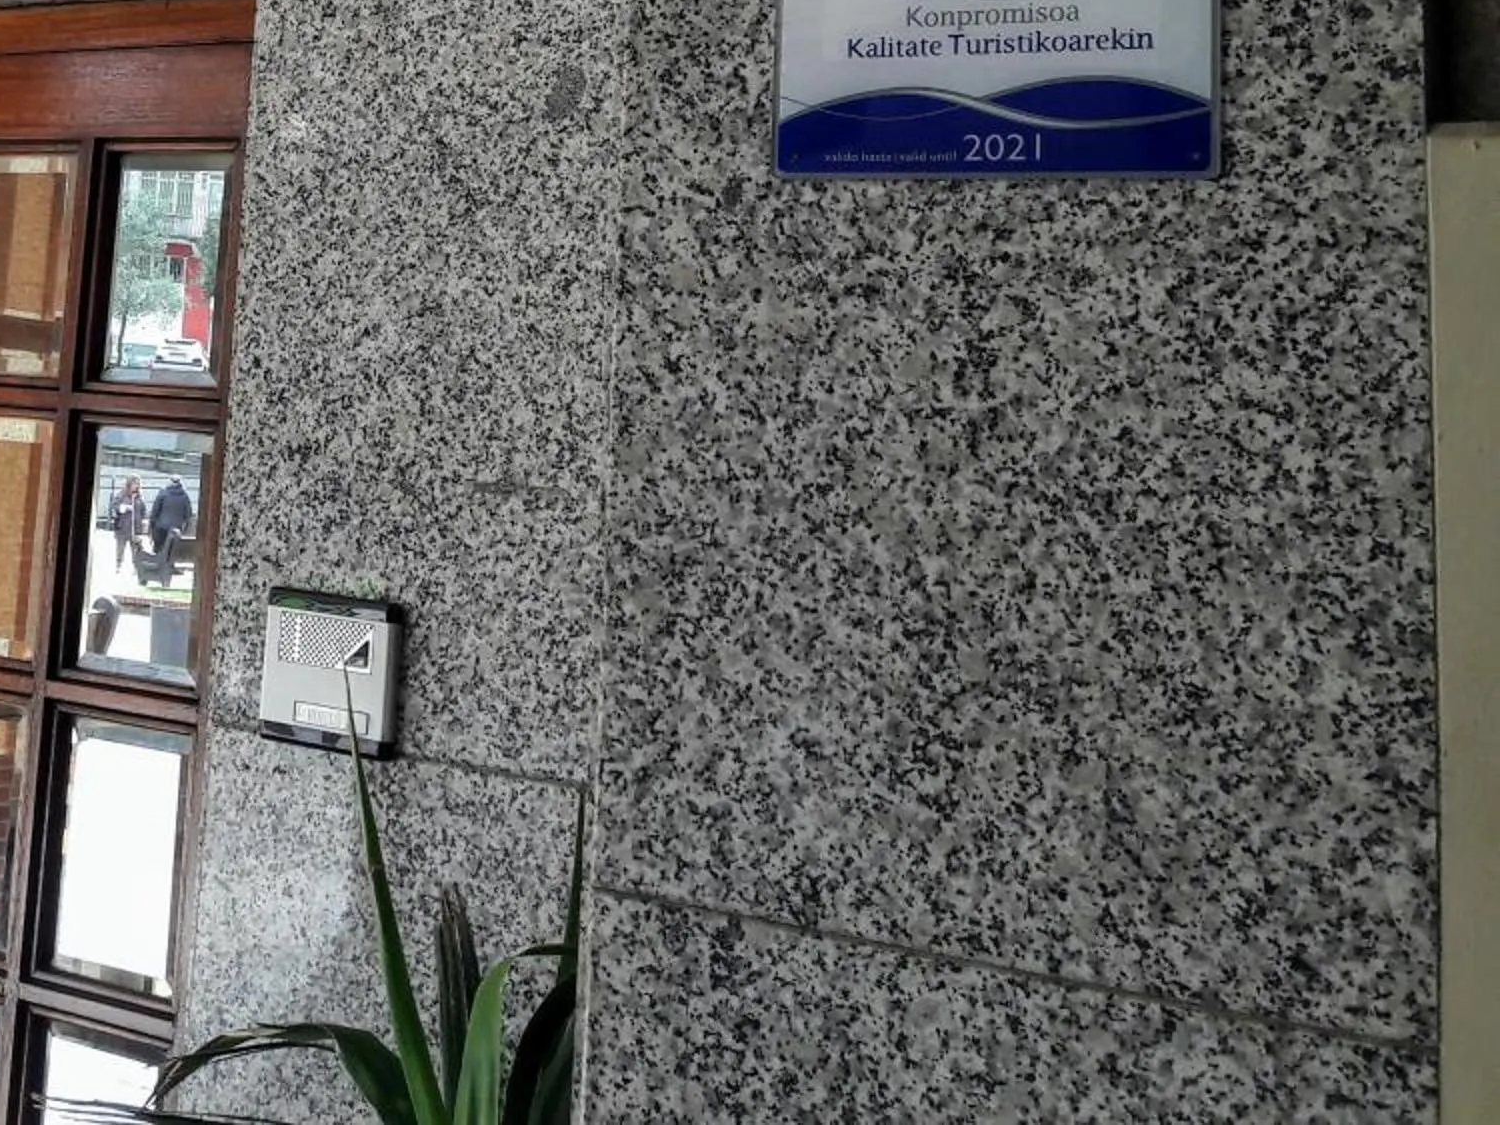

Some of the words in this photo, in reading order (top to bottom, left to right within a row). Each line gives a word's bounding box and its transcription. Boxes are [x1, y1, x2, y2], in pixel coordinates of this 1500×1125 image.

[905, 2, 1080, 31] Konpromisoa
[847, 36, 943, 59] Kalitate
[947, 27, 1155, 56] Turistikoarekin
[963, 132, 1042, 162] 2021
